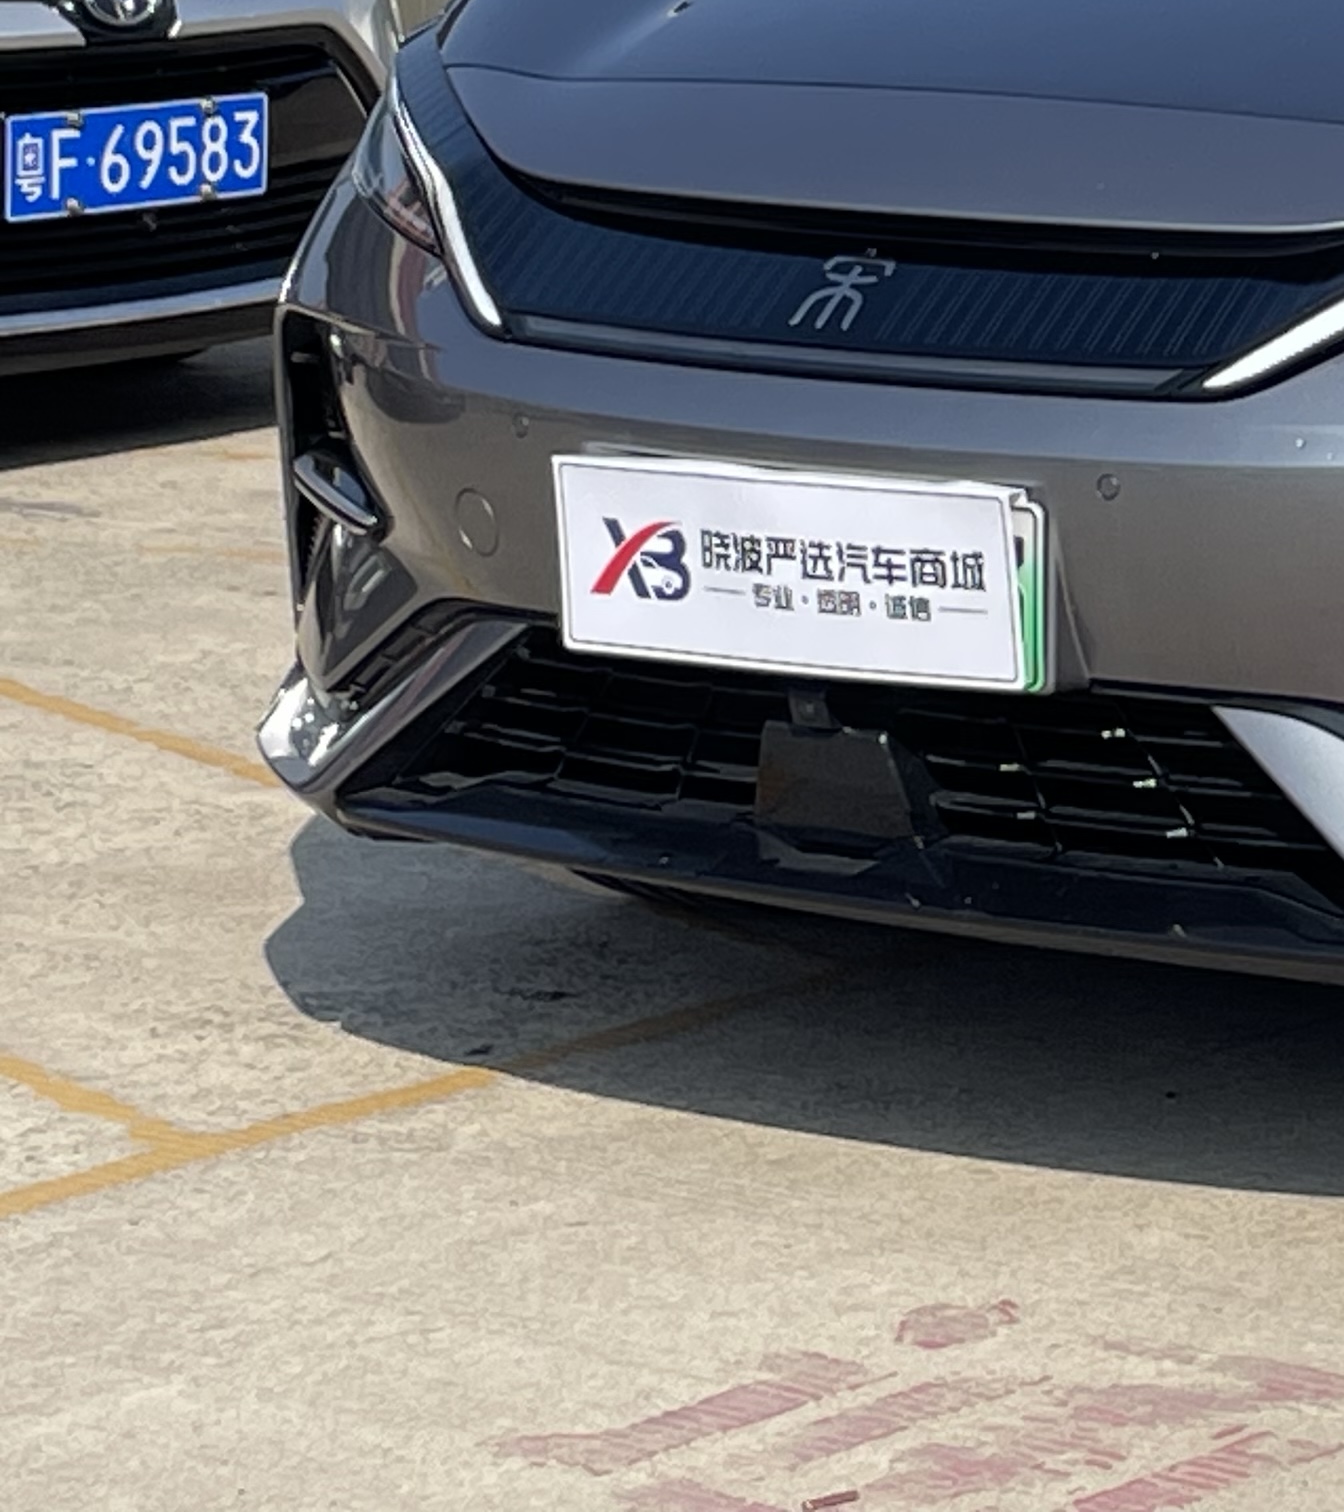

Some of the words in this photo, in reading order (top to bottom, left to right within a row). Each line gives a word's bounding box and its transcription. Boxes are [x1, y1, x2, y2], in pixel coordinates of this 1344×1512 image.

[700, 529, 986, 592] 晓波严选汽车商城
